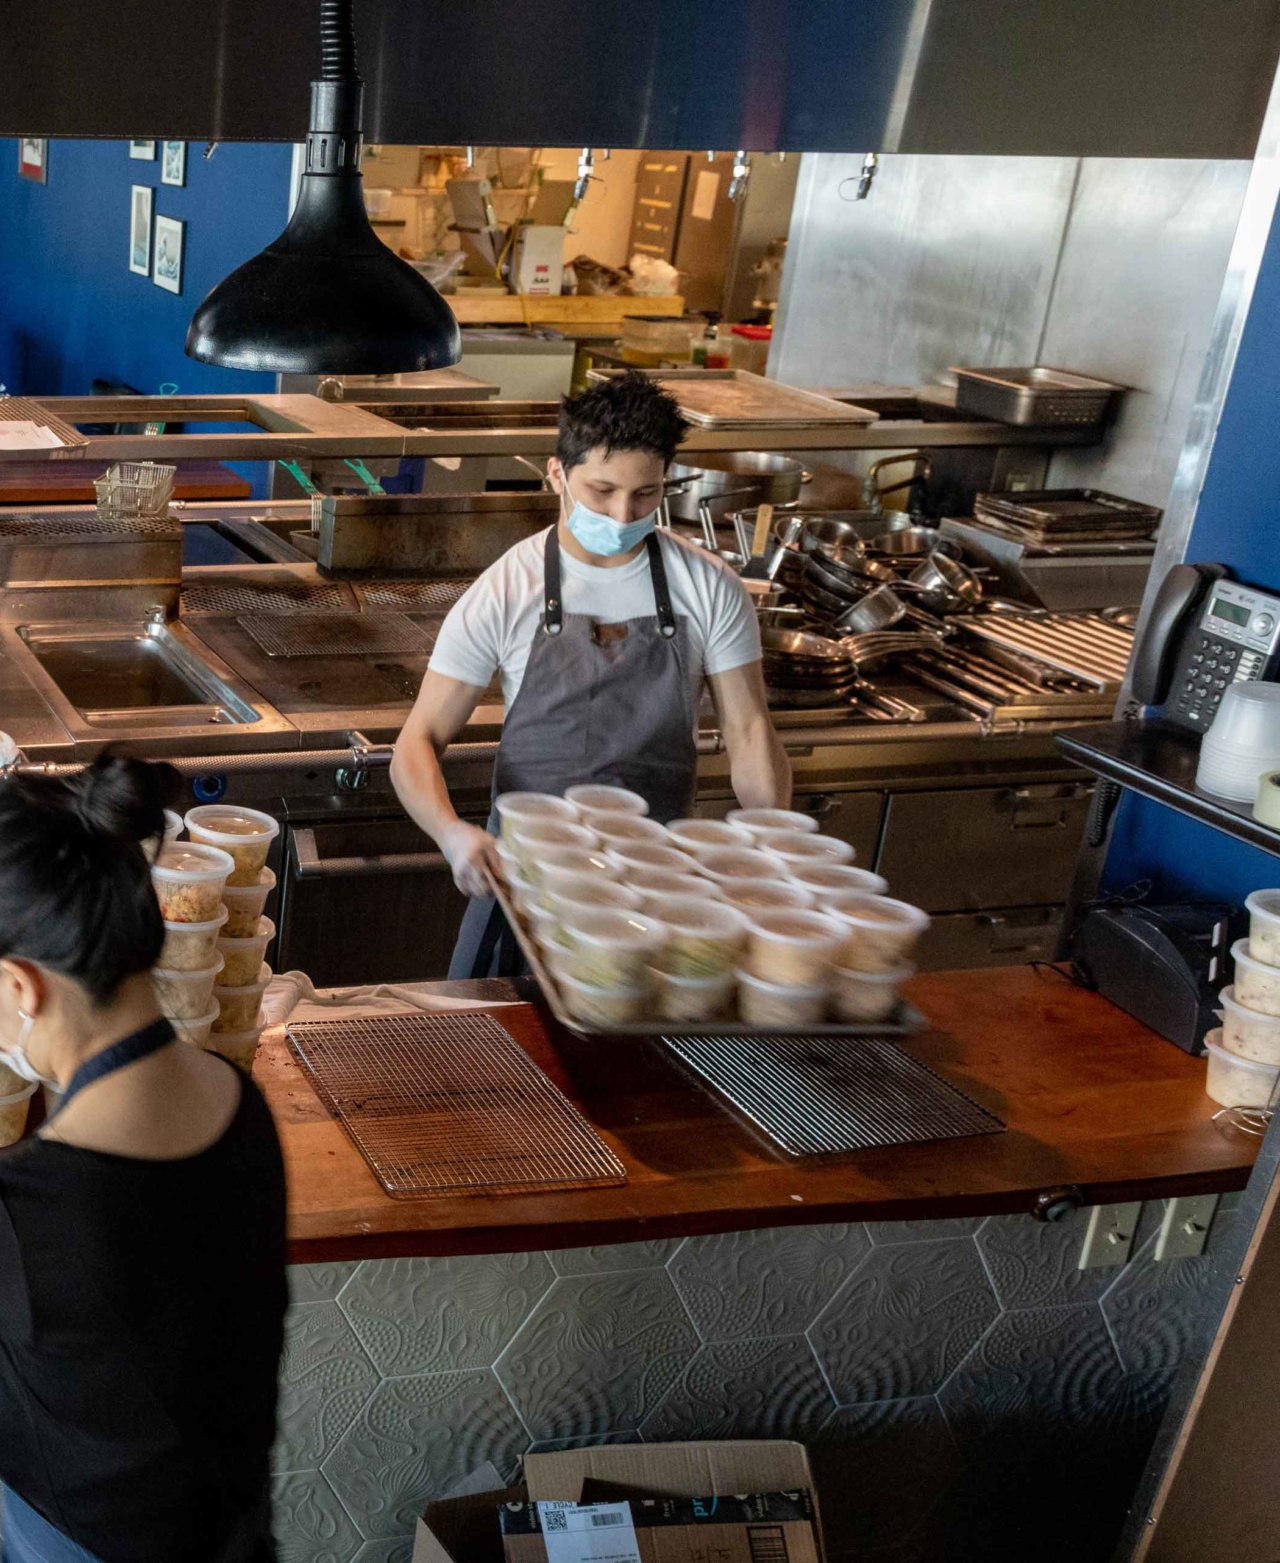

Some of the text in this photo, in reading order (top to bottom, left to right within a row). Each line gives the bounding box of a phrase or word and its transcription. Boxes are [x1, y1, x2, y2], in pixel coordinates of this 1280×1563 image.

[1203, 640, 1236, 659] 1 2 3
[1210, 660, 1217, 668] 5
[1224, 666, 1230, 674] 6
[1192, 669, 1199, 677] 7
[1219, 680, 1225, 688] 9
[1201, 689, 1207, 697] 0
